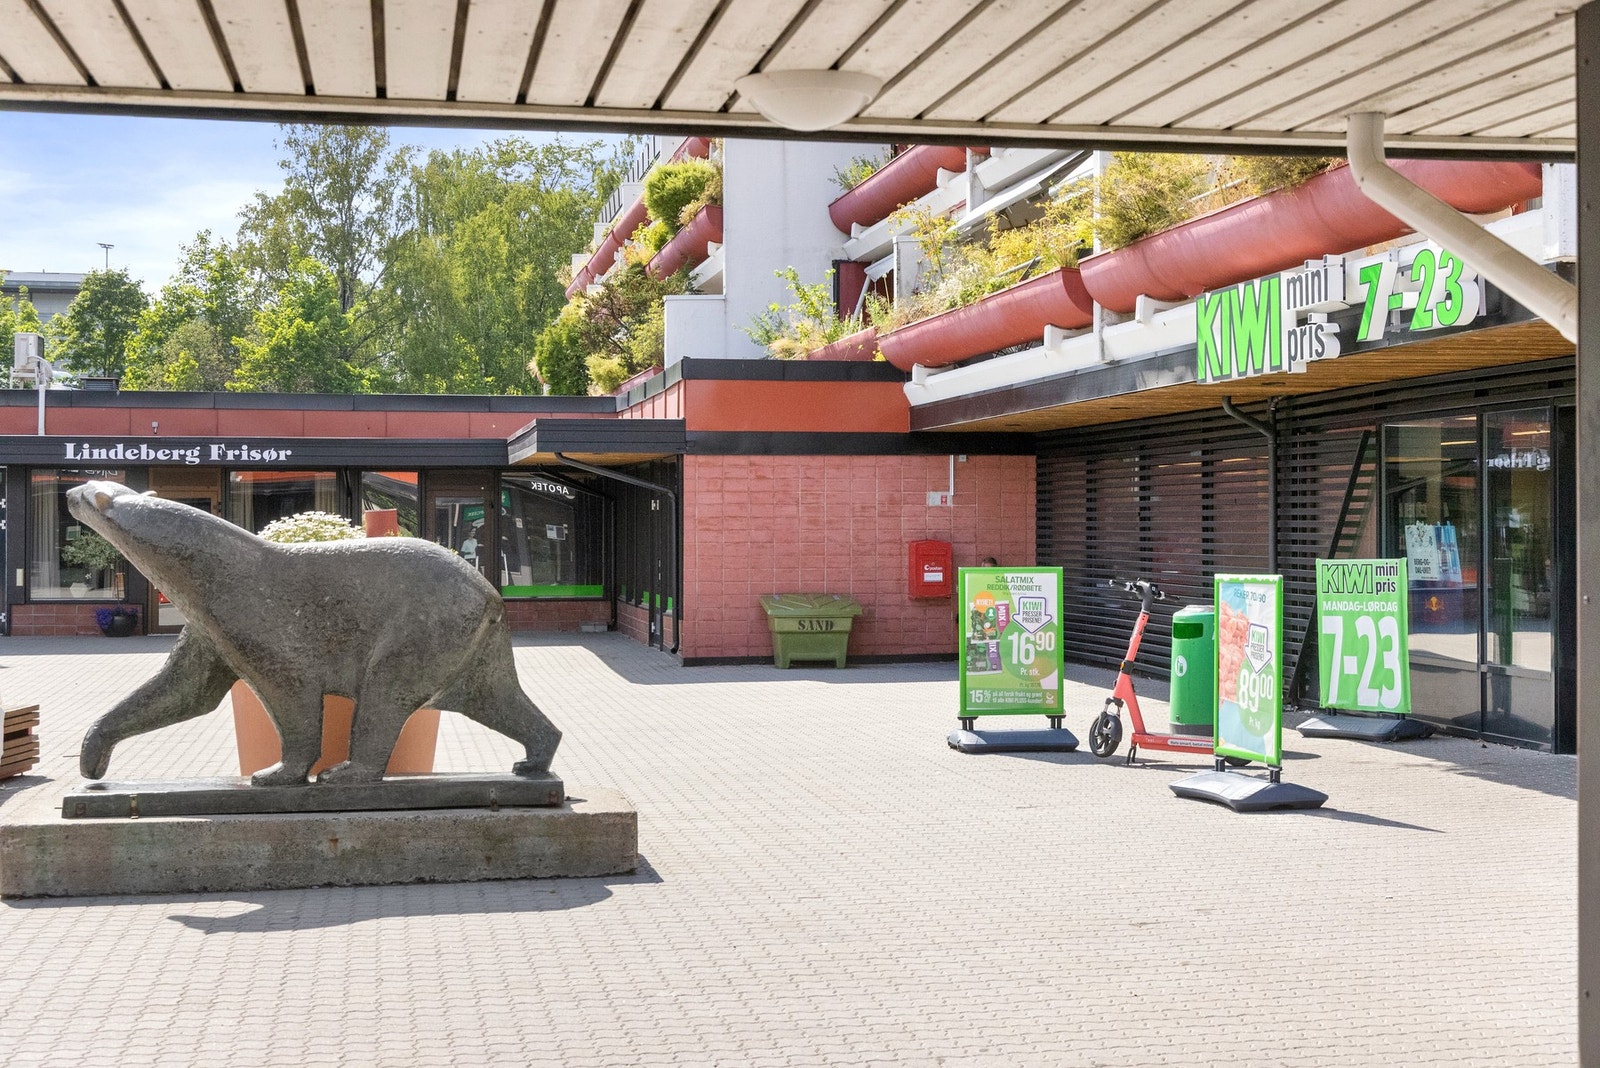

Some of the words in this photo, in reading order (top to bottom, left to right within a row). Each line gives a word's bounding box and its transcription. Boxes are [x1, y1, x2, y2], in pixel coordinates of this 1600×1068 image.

[1286, 266, 1329, 311] mini
[1196, 275, 1282, 384] KIWI
[1287, 320, 1326, 364] pris
[64, 442, 201, 465] Lindeberg
[209, 443, 292, 463] Frisør
[1375, 562, 1398, 577] mini
[995, 576, 1034, 584] SALATMIX
[1321, 563, 1374, 594] KIWI
[1376, 578, 1396, 595] pris
[998, 606, 1006, 621] MIX
[1022, 601, 1042, 610] KIWI
[1322, 600, 1398, 612] MANDAG-LØRDAG
[798, 619, 834, 631] SAND
[1322, 615, 1402, 709] 7-23
